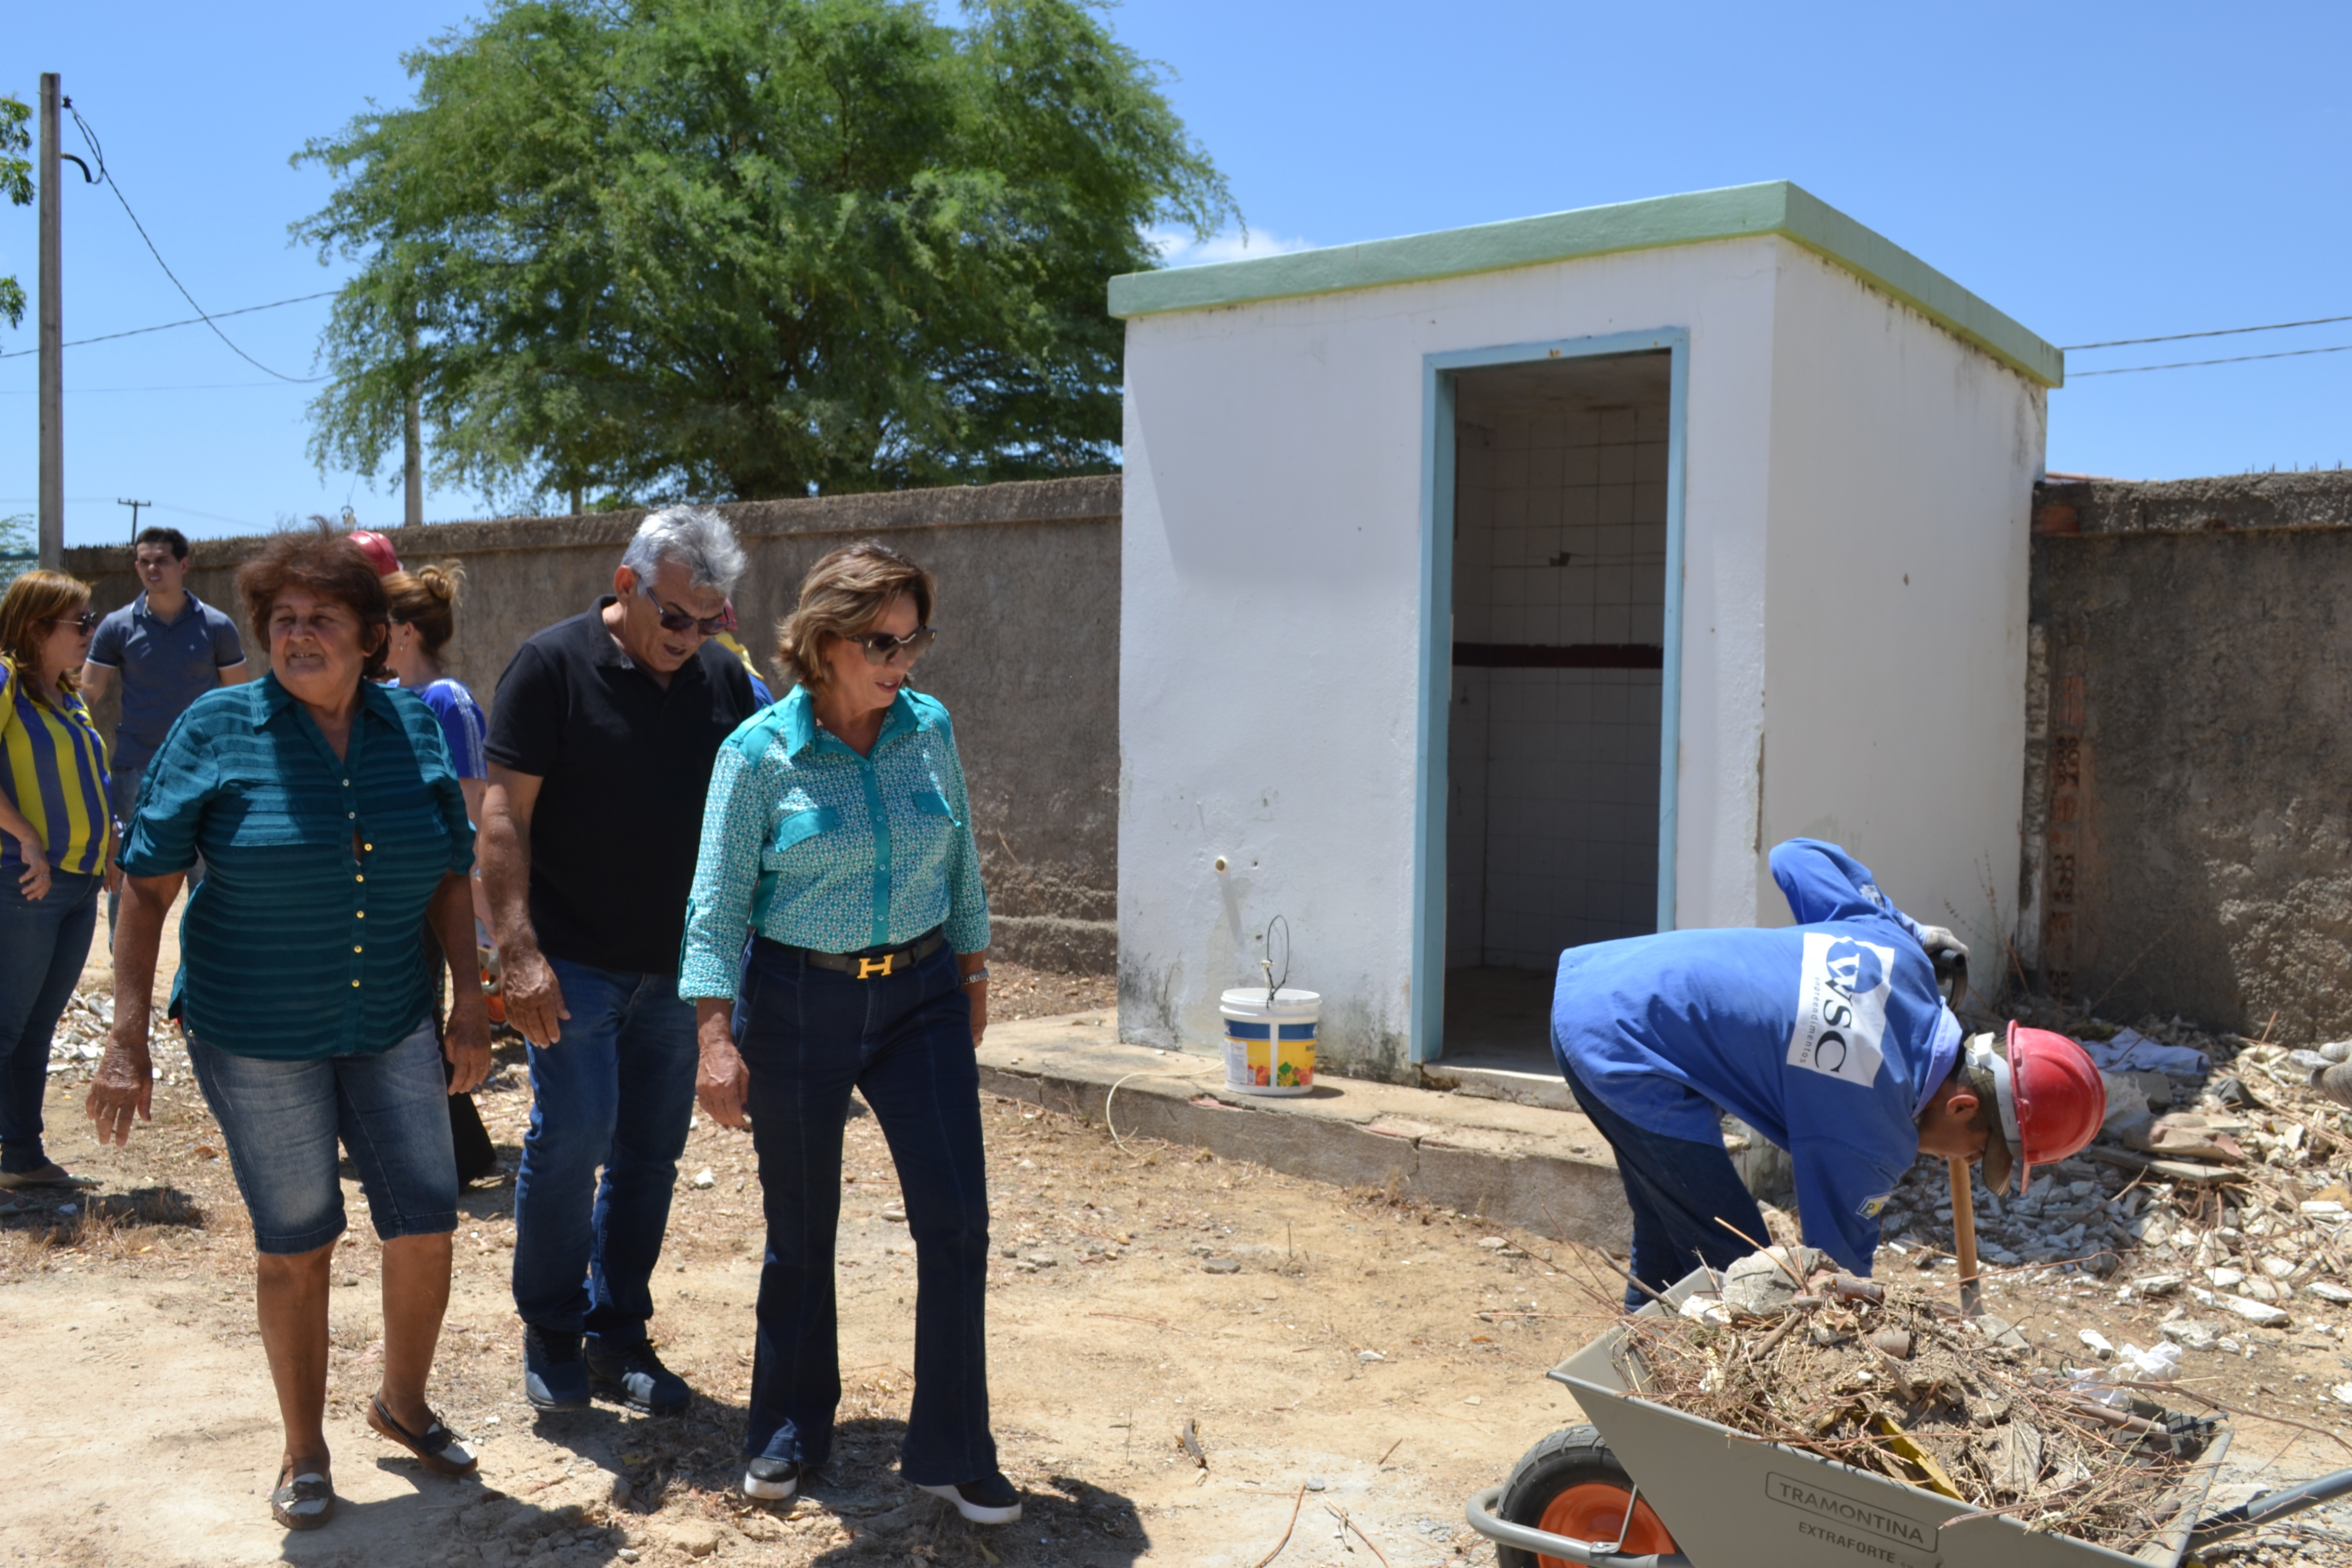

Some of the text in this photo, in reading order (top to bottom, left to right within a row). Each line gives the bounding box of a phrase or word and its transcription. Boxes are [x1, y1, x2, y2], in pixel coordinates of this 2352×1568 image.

[1800, 977, 1820, 1063] empreendimentos
[1815, 953, 1859, 1073] WSC
[1779, 1482, 1923, 1544] TRAMONTINA
[1799, 1522, 1895, 1563] EXTRAFORTE
